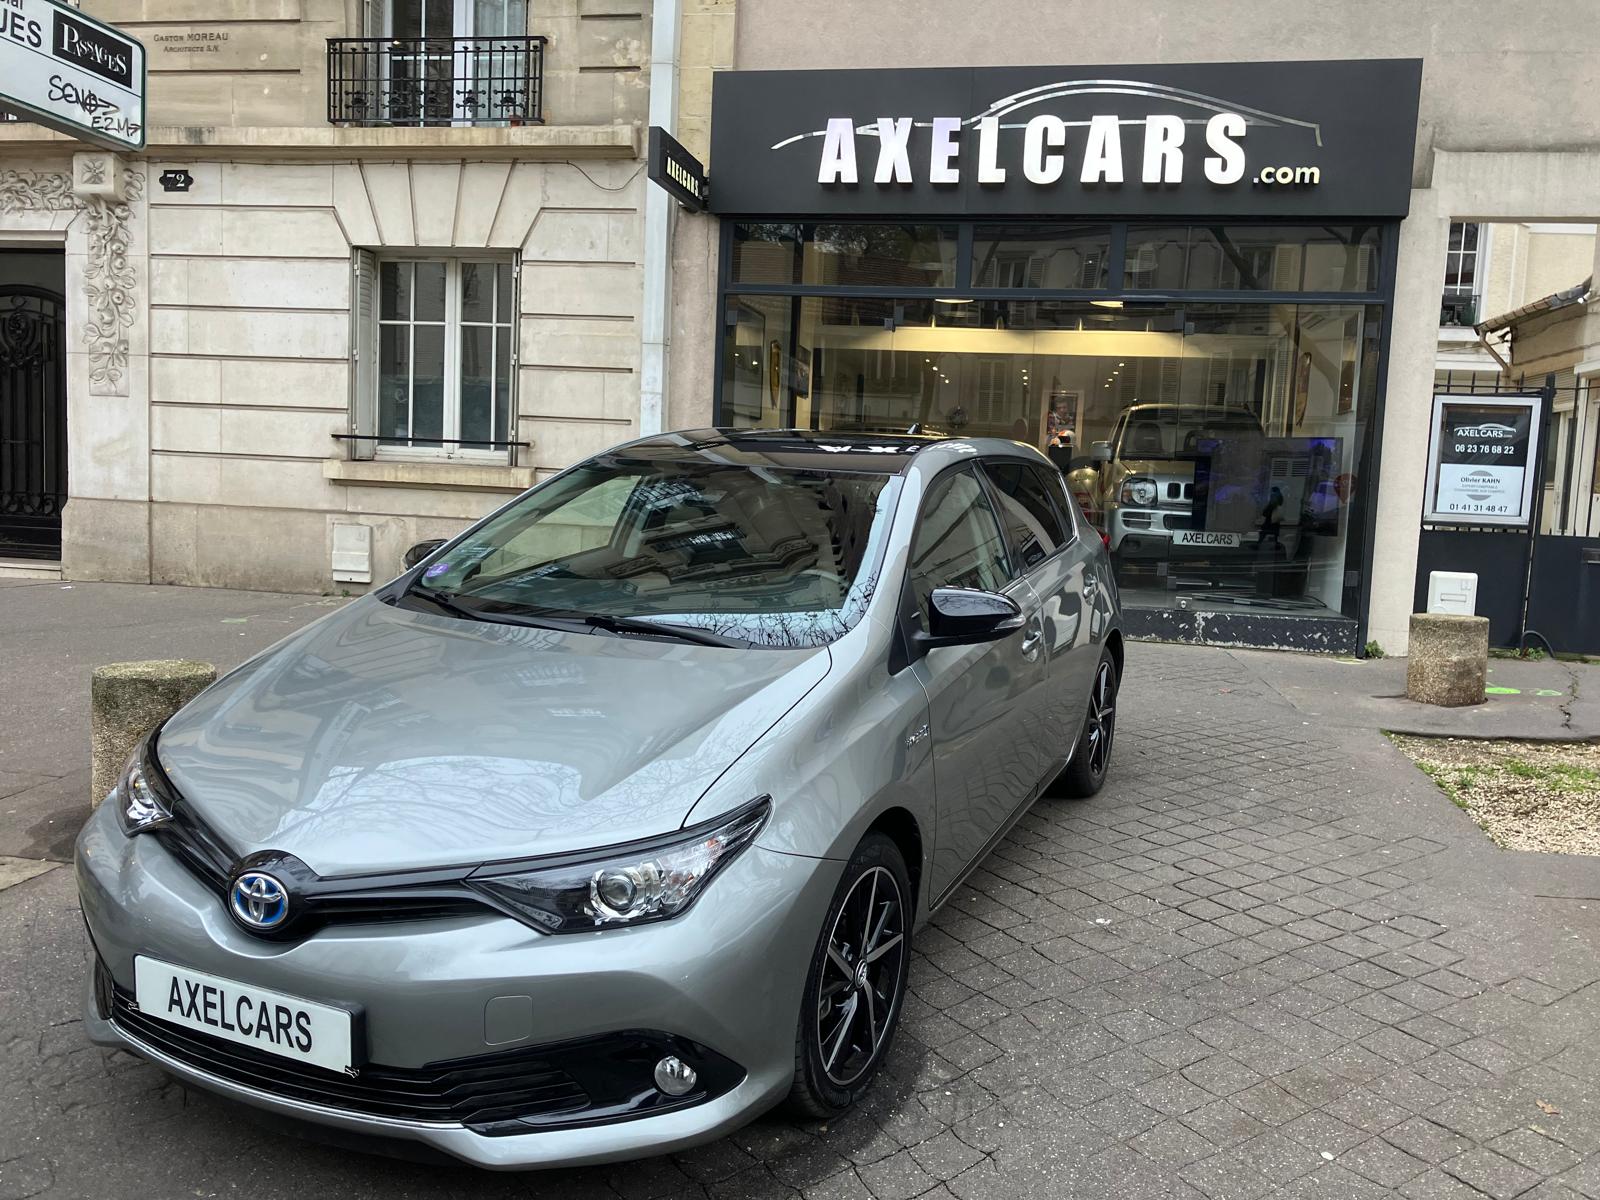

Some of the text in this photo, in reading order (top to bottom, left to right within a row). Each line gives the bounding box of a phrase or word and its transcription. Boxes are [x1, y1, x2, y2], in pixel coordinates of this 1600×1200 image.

[187, 32, 229, 41] MOREAU
[61, 22, 127, 76] PASSAGES
[166, 173, 185, 187] 72
[666, 156, 699, 197] AXELCARS
[1455, 444, 1465, 453] 06
[1467, 445, 1477, 453] 23
[1504, 446, 1514, 454] 22
[1449, 503, 1459, 511] 01
[1473, 504, 1483, 512] 31
[1497, 505, 1508, 513] 47
[1181, 532, 1233, 545] AXELCARS
[168, 976, 312, 1053] AXELCARS
